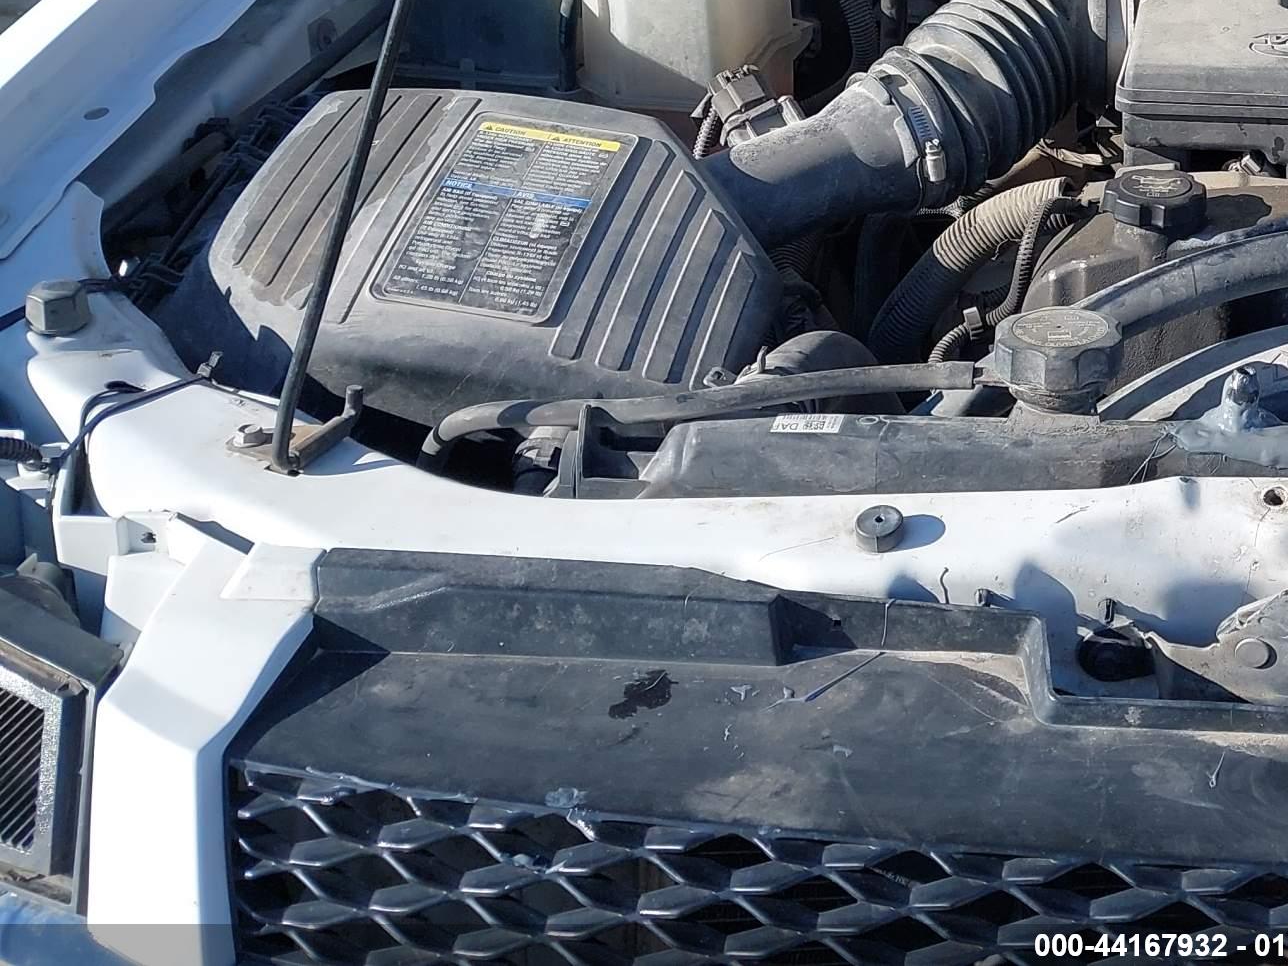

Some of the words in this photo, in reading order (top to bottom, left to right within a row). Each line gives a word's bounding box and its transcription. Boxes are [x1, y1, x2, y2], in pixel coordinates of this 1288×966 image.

[495, 127, 528, 135] CAUTION
[563, 137, 602, 147] ATTENTION
[445, 180, 473, 188] NOTICE
